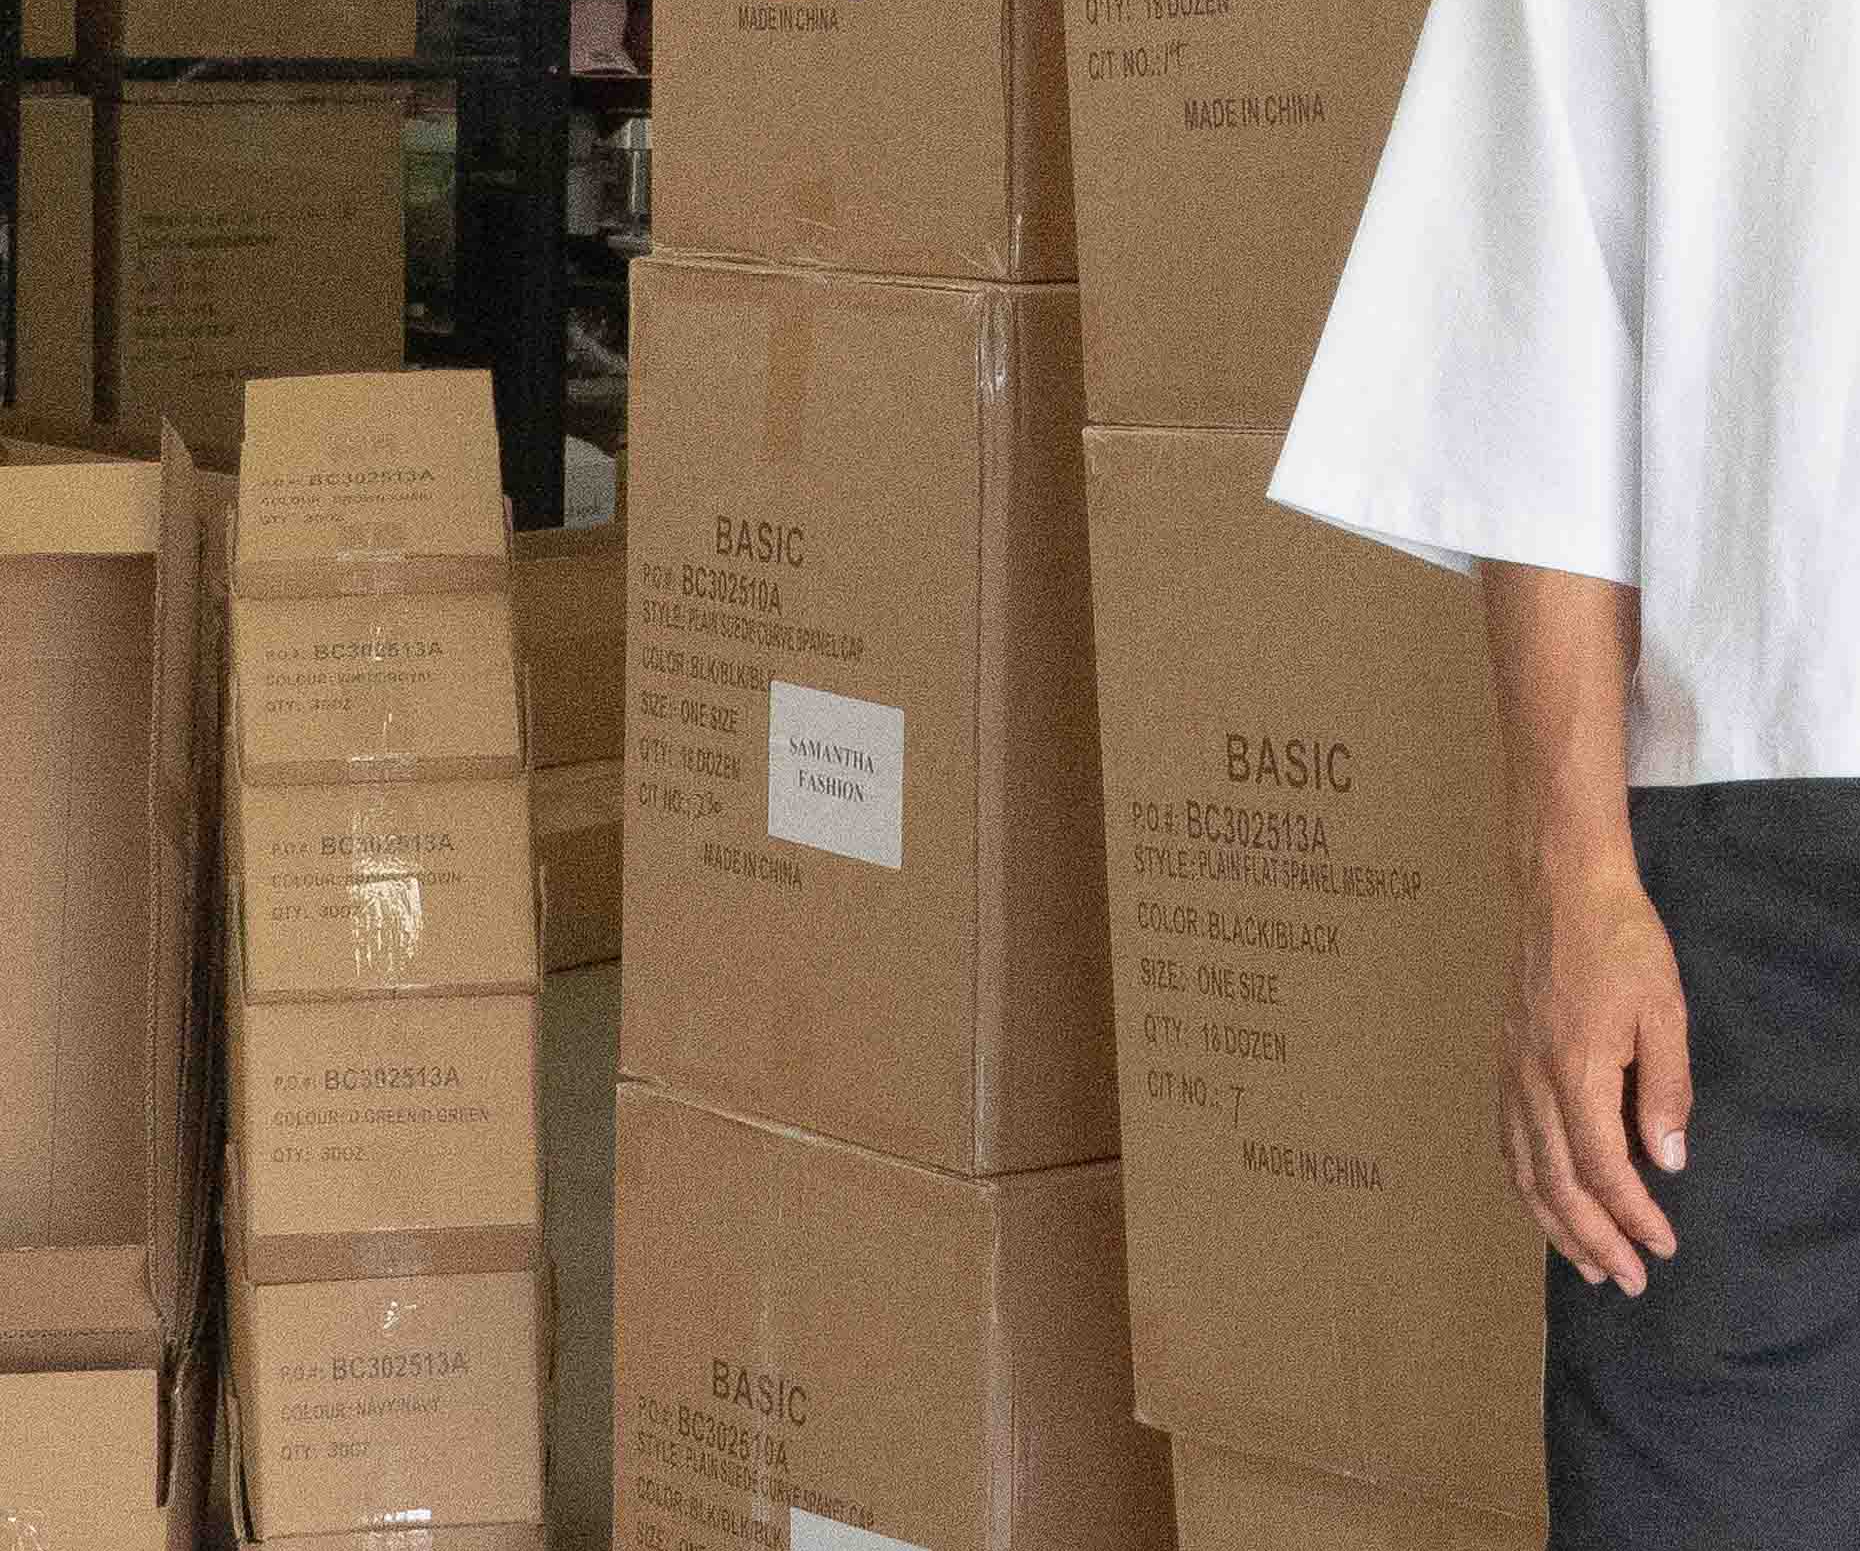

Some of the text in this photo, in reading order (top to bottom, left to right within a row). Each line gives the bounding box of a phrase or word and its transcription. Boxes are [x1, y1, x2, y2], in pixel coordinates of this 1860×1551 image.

[738, 6, 838, 32] MADE IN CHINA
[1184, 93, 1326, 131] MADE IN CHINA
[716, 514, 805, 568] BASIC
[682, 563, 783, 617] BC302510A
[789, 737, 875, 775] SAMANTHA
[1226, 733, 1350, 793] BASIC
[799, 768, 865, 803] FASHION
[1186, 798, 1330, 858] BC302513A
[1199, 849, 1241, 882] PLAIN
[1244, 854, 1279, 889] FLAT
[1342, 865, 1386, 900] MESH
[1389, 867, 1421, 901] CAP
[1207, 909, 1340, 958] BLACK/BLACK
[1140, 956, 1280, 1006] SIZE: ONE SIZE
[1224, 1025, 1287, 1064] DOZEN
[324, 1065, 463, 1092] BC302513A
[1242, 1139, 1384, 1192] MADE IN CHINA
[332, 1351, 469, 1381] BC302513A
[712, 1357, 807, 1426] BASIC
